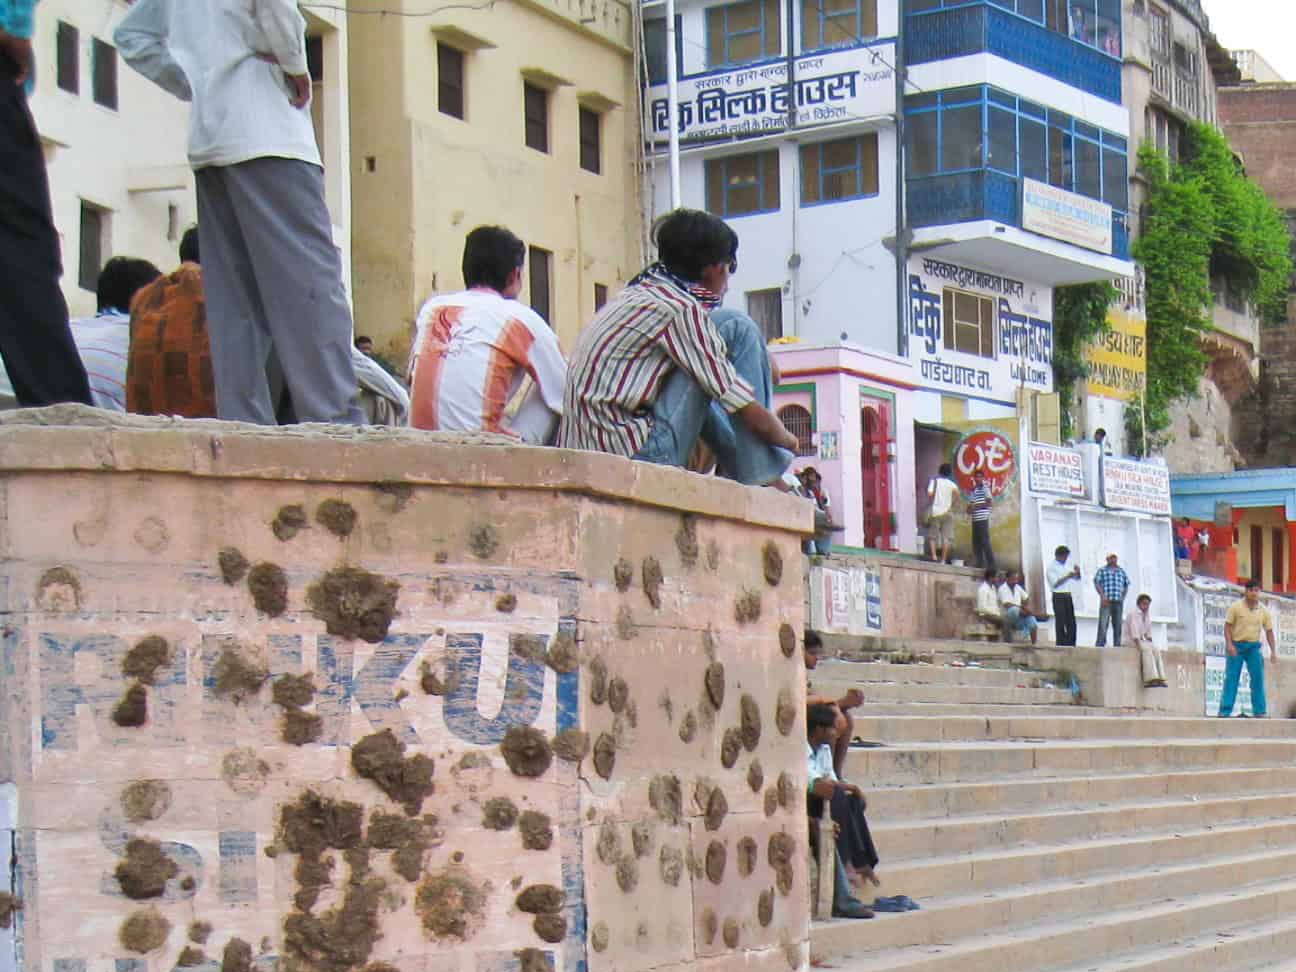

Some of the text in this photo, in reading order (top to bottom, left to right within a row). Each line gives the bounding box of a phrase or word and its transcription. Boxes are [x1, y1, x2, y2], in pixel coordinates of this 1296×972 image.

[696, 87, 766, 124] सिल्क
[923, 257, 958, 281] सरकार
[1010, 363, 1047, 385] WLCOME
[1032, 462, 1056, 478] REST
[38, 630, 552, 750] RINKU
